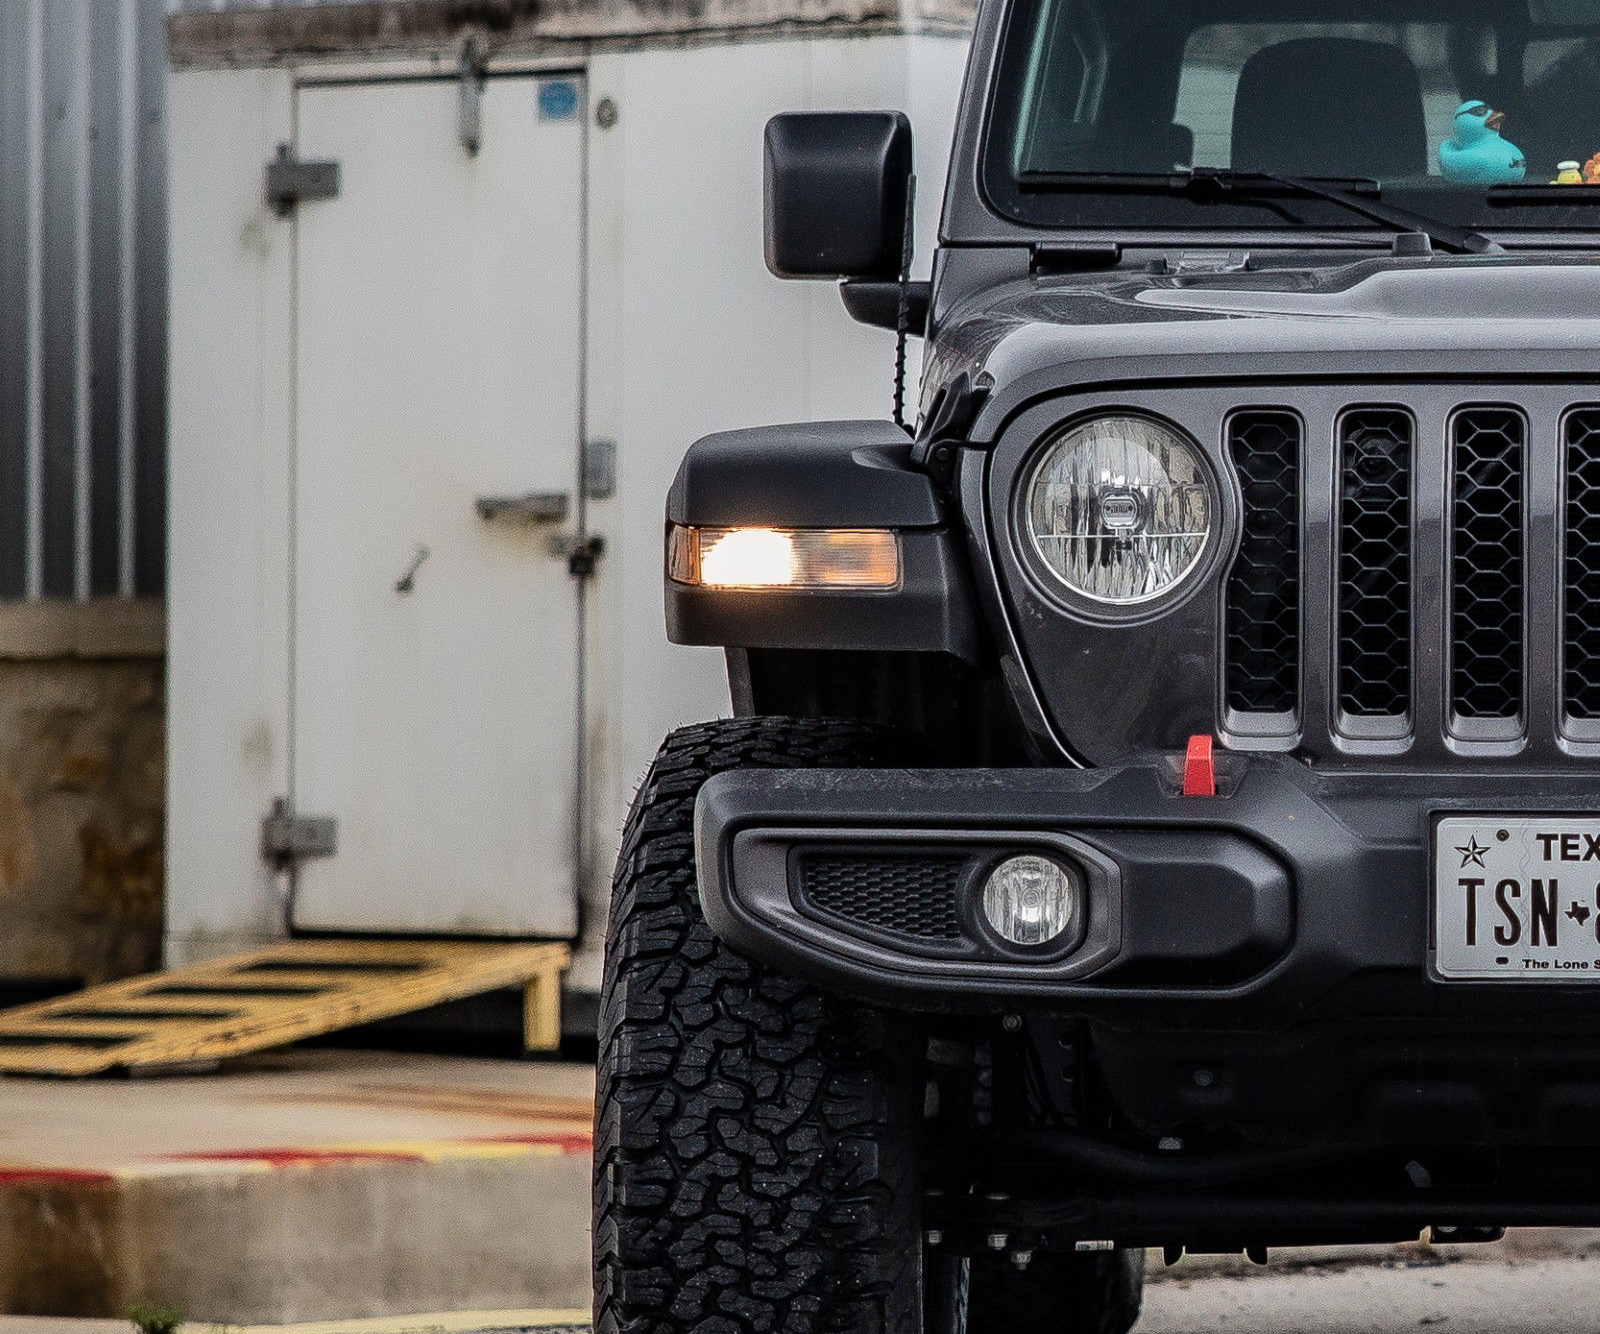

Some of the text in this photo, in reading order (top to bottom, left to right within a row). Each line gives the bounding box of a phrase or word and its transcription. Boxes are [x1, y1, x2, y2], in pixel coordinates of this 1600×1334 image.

[1458, 878, 1559, 948] TSN
[1522, 959, 1549, 970] The
[1554, 959, 1589, 970] Lone
